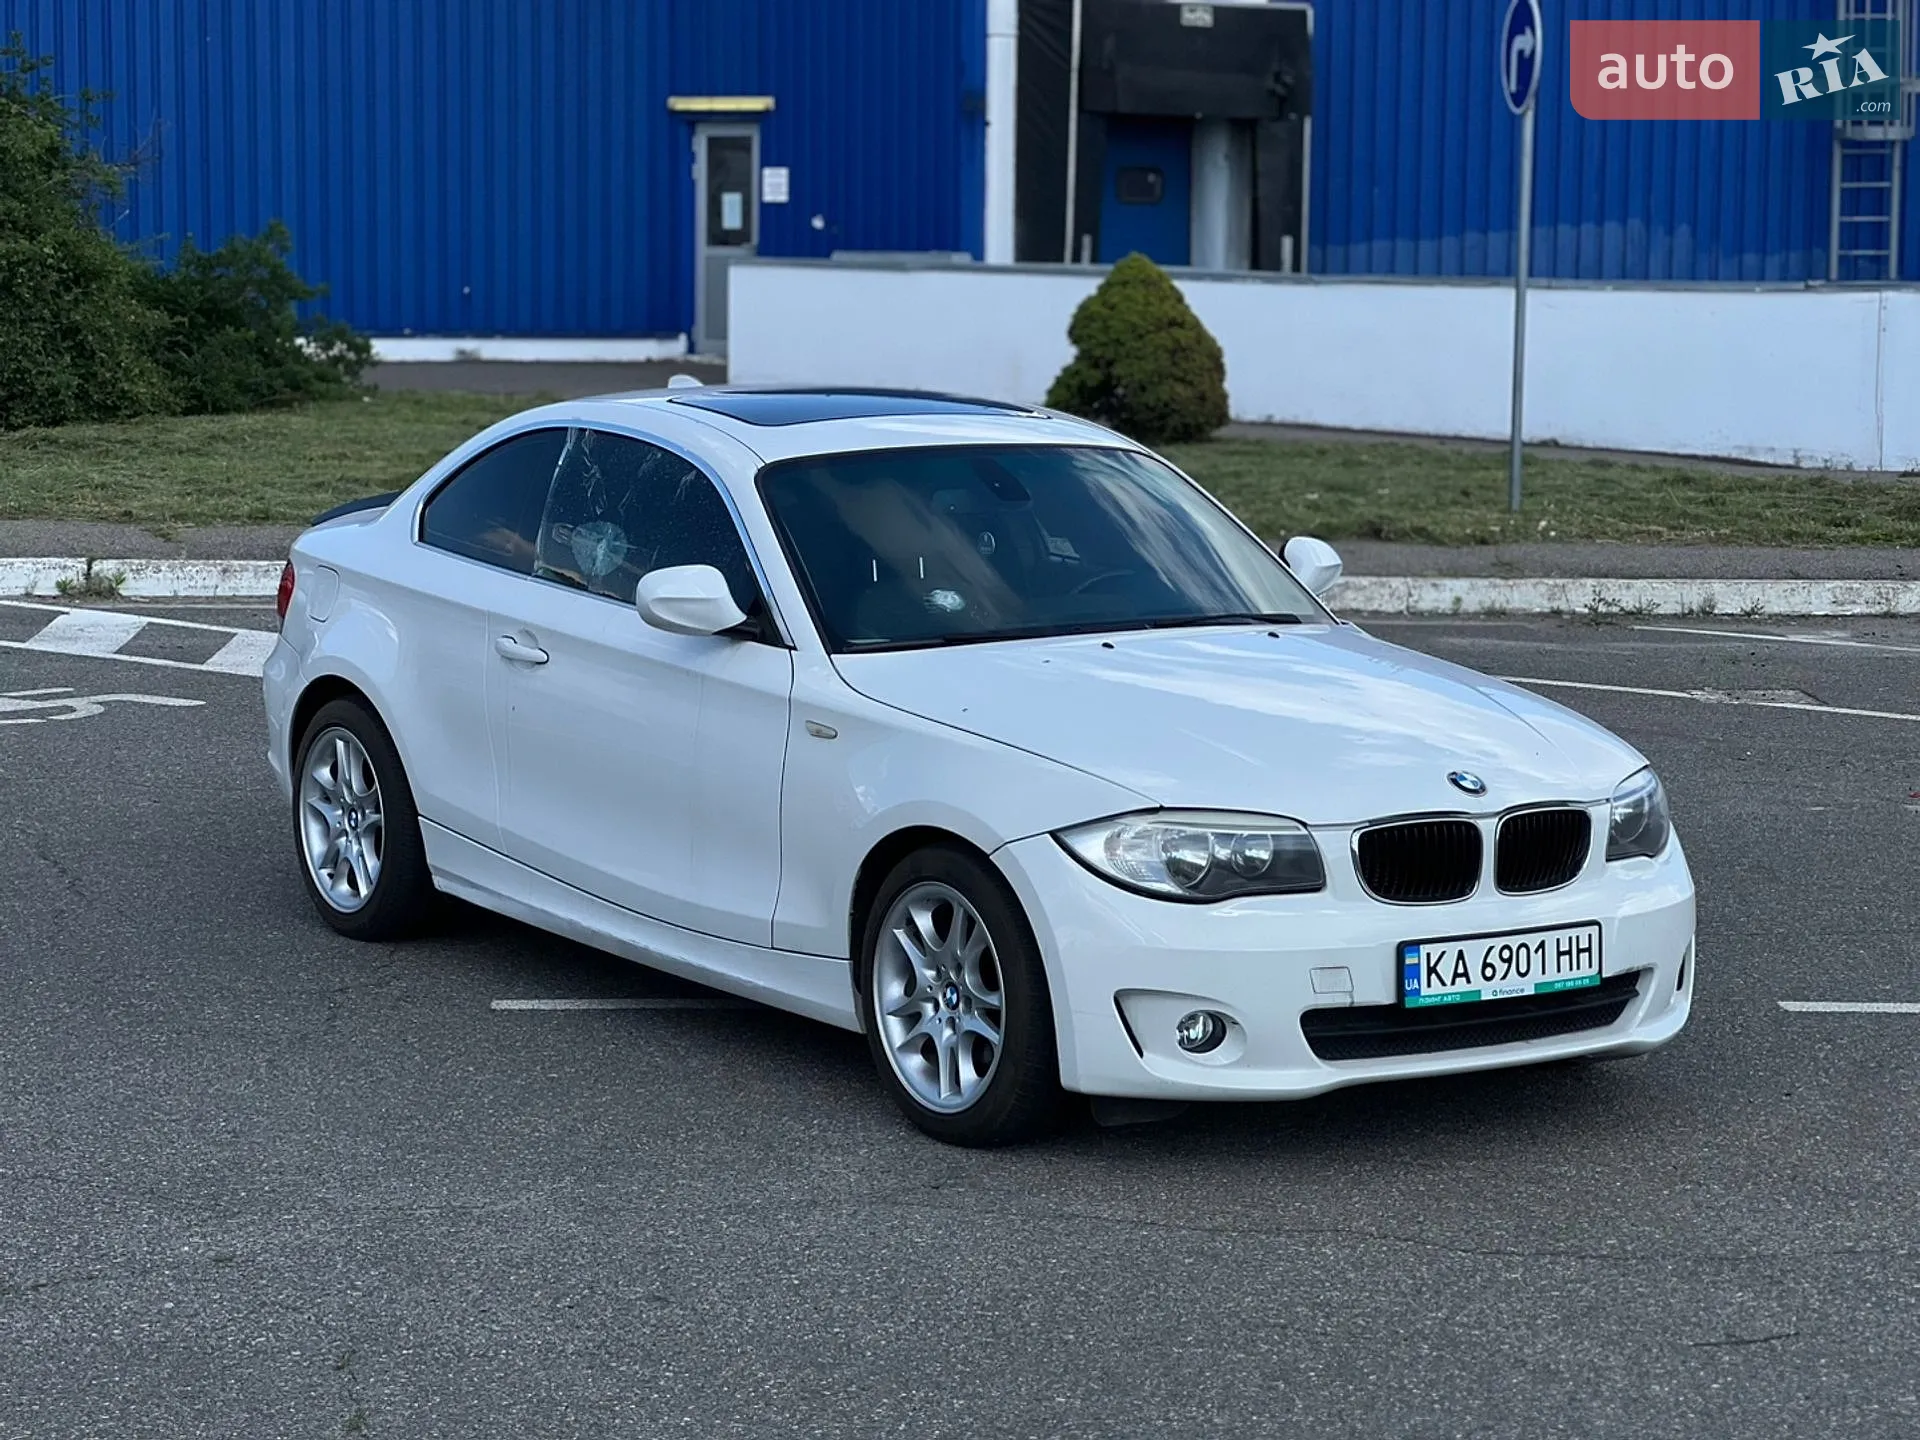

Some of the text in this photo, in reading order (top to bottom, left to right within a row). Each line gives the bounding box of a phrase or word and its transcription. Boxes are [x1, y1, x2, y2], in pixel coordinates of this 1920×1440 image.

[1426, 934, 1593, 988] KA 6901 HH
[1405, 978, 1419, 990] UA
